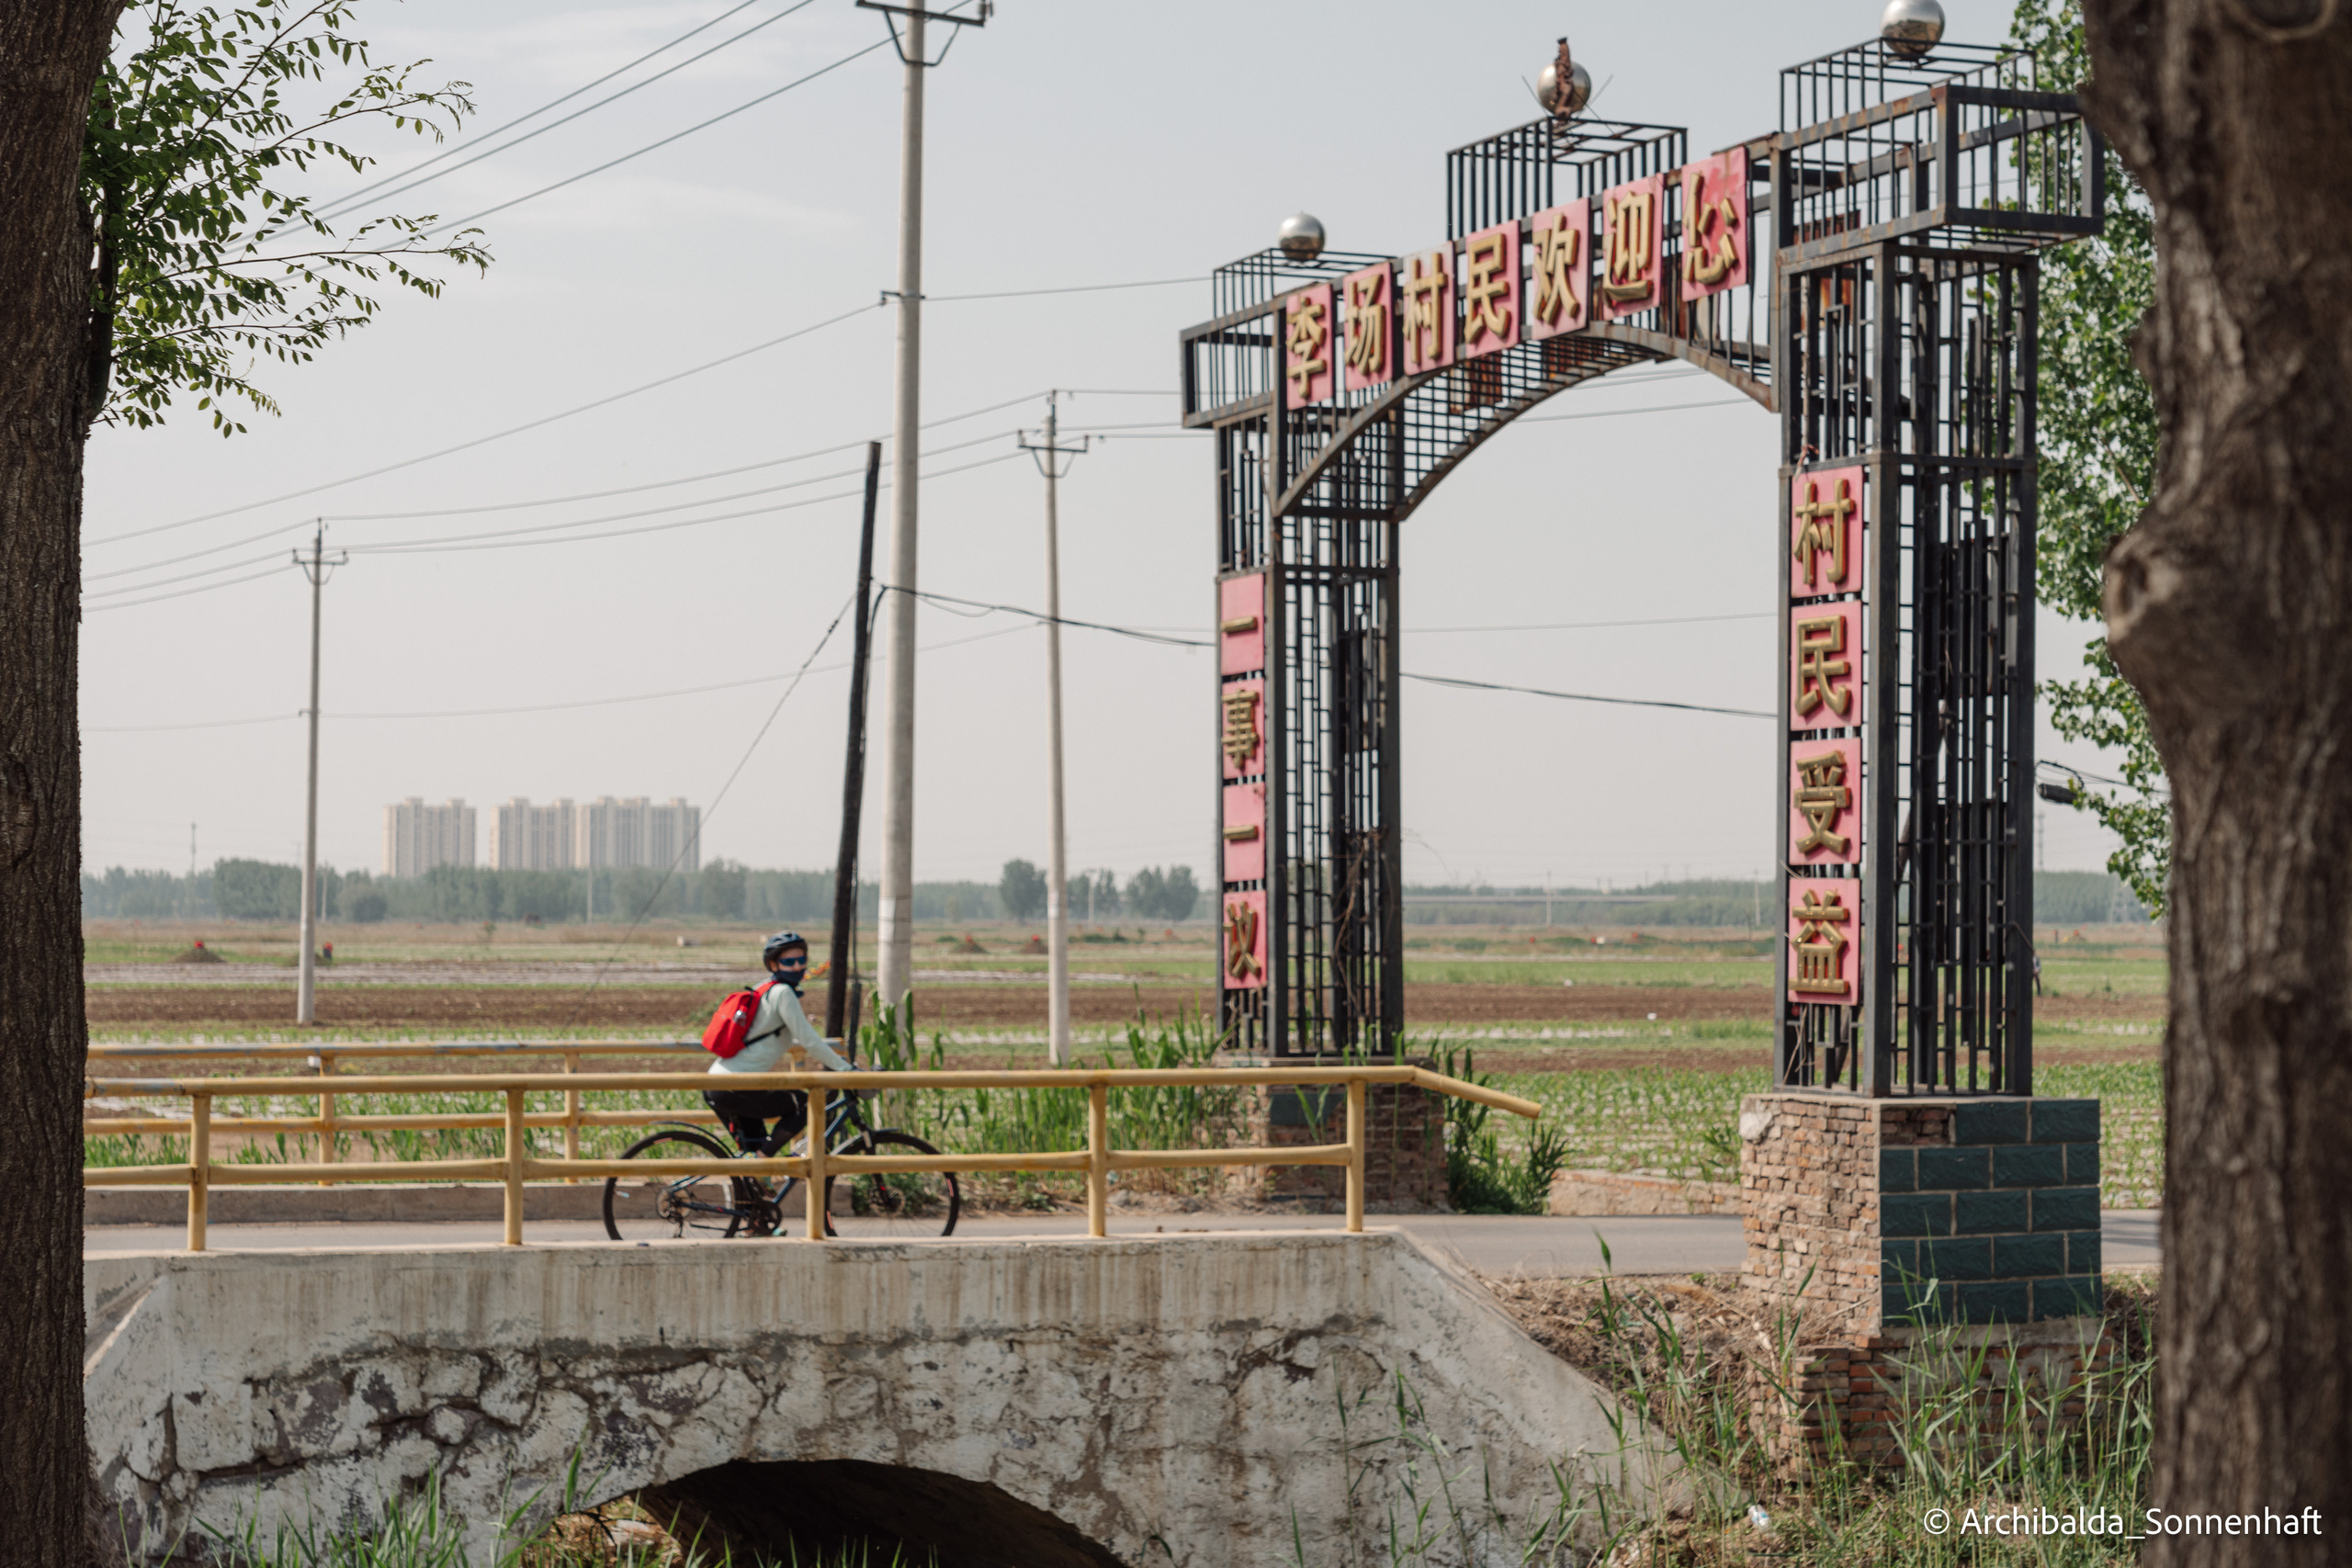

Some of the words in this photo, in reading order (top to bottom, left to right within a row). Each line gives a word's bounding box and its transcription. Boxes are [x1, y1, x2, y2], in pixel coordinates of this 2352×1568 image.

[1220, 615, 1263, 981] 一事一议
[1788, 478, 1856, 996] 村民受益
